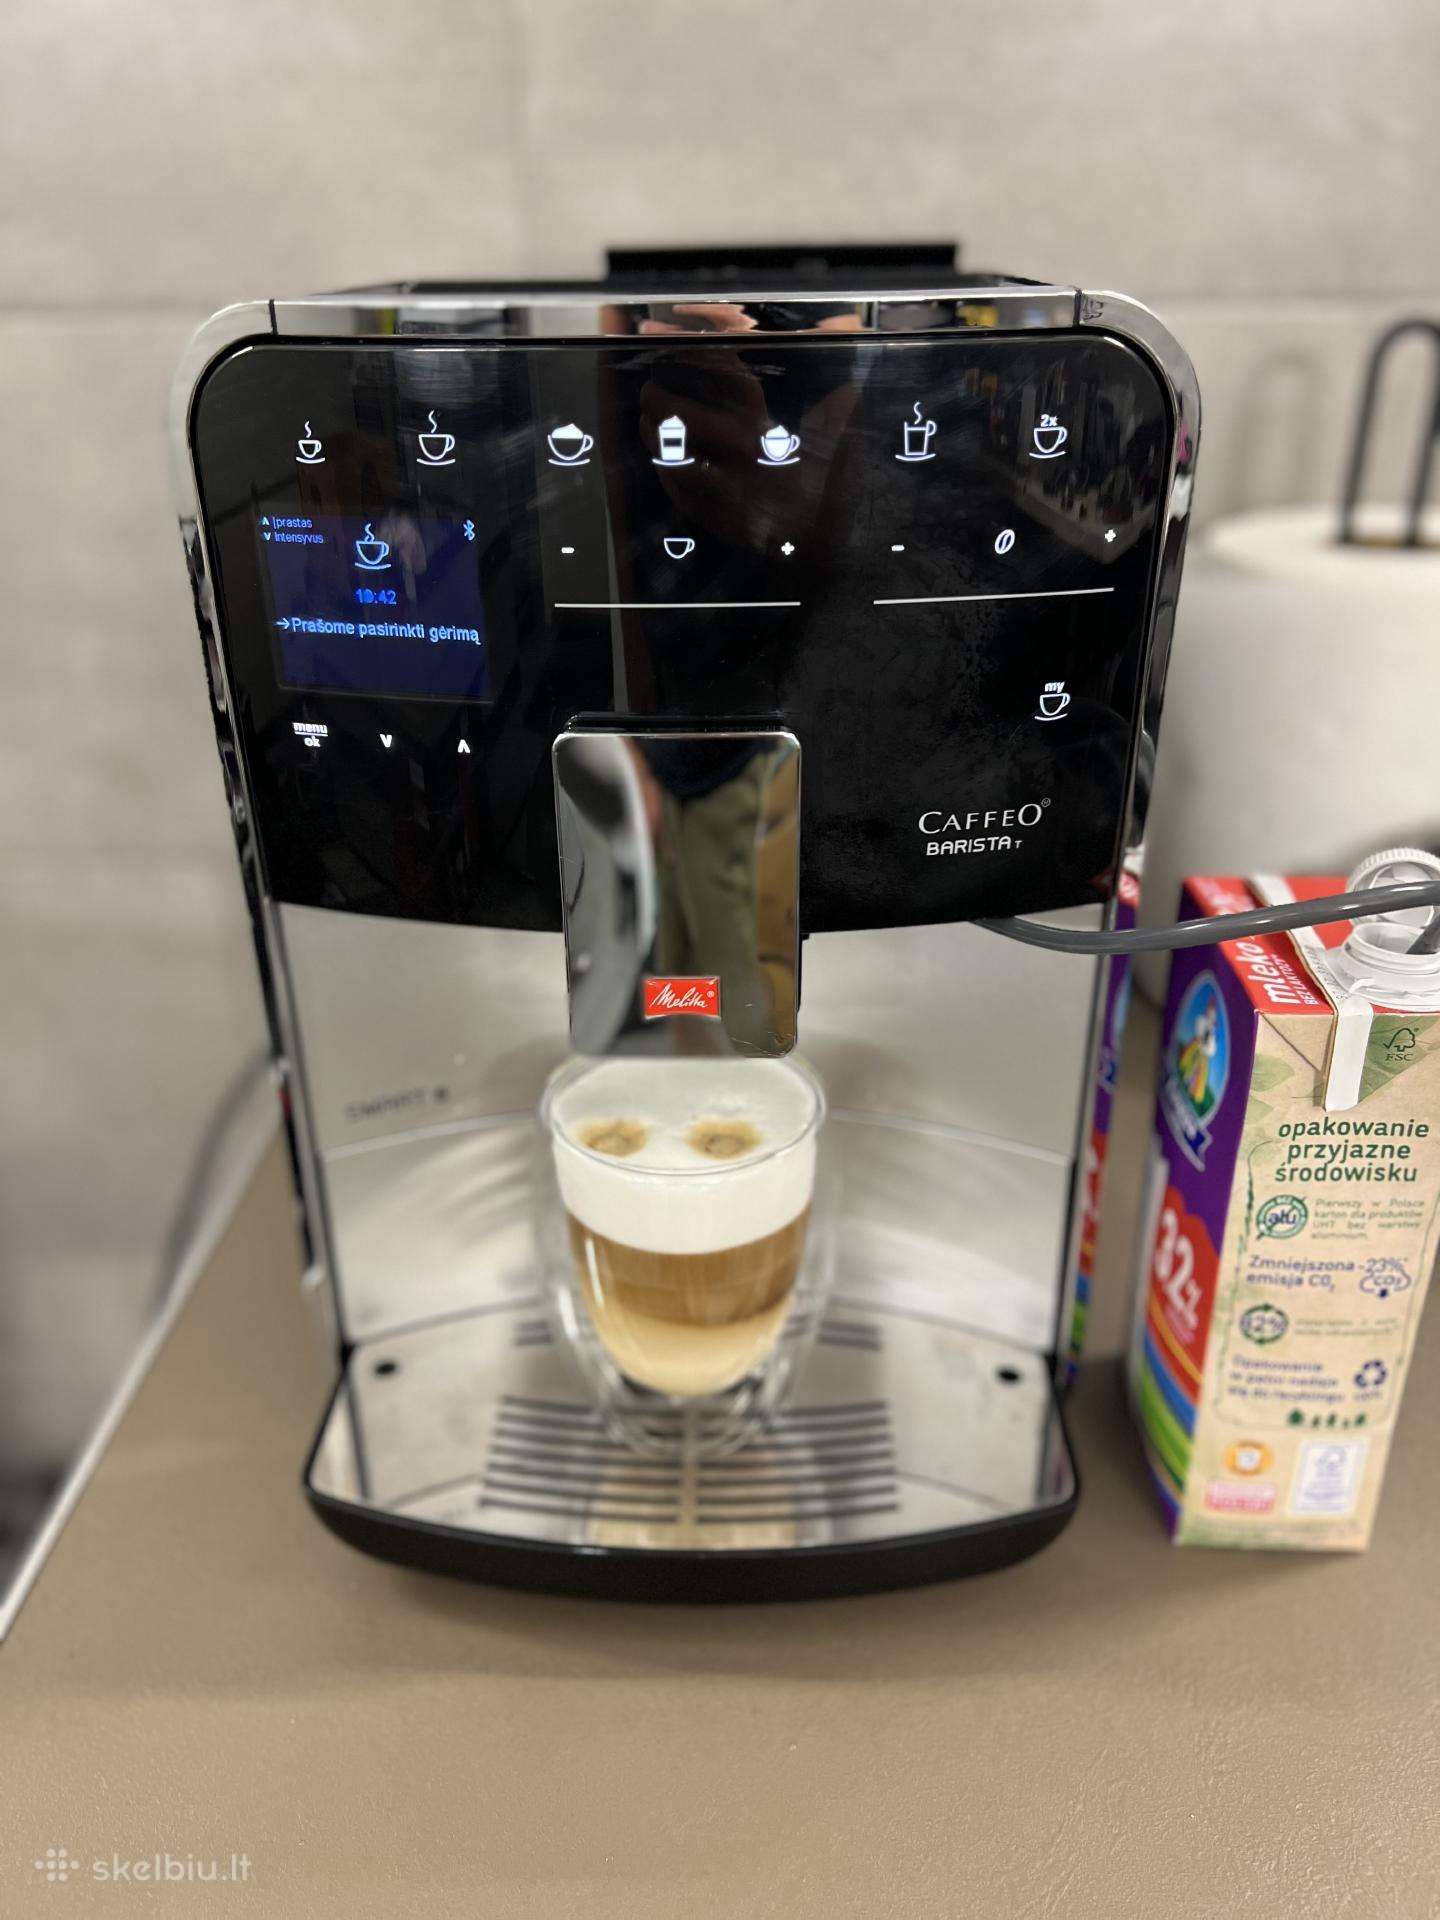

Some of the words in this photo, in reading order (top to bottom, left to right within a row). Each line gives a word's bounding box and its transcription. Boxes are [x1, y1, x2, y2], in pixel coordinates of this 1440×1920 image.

[1040, 414, 1058, 427] 2x
[272, 517, 312, 529] Įprastas
[274, 532, 324, 544] Intensyvus
[291, 617, 355, 634] Prašome
[360, 622, 425, 638] pasirinkti
[429, 626, 481, 645] gėrimą
[1044, 681, 1065, 692] my
[292, 722, 328, 733] menu
[304, 736, 320, 747] ok
[926, 836, 1011, 856] BARISTA
[1236, 942, 1300, 1004] mleko
[1295, 990, 1319, 1004] BEZ
[1278, 1116, 1430, 1140] opakowanie
[1287, 1142, 1411, 1165] przyjazne
[1275, 1160, 1418, 1182] środowisku
[1249, 1255, 1355, 1274] Zmniejszona
[1246, 1273, 1303, 1288] emisja
